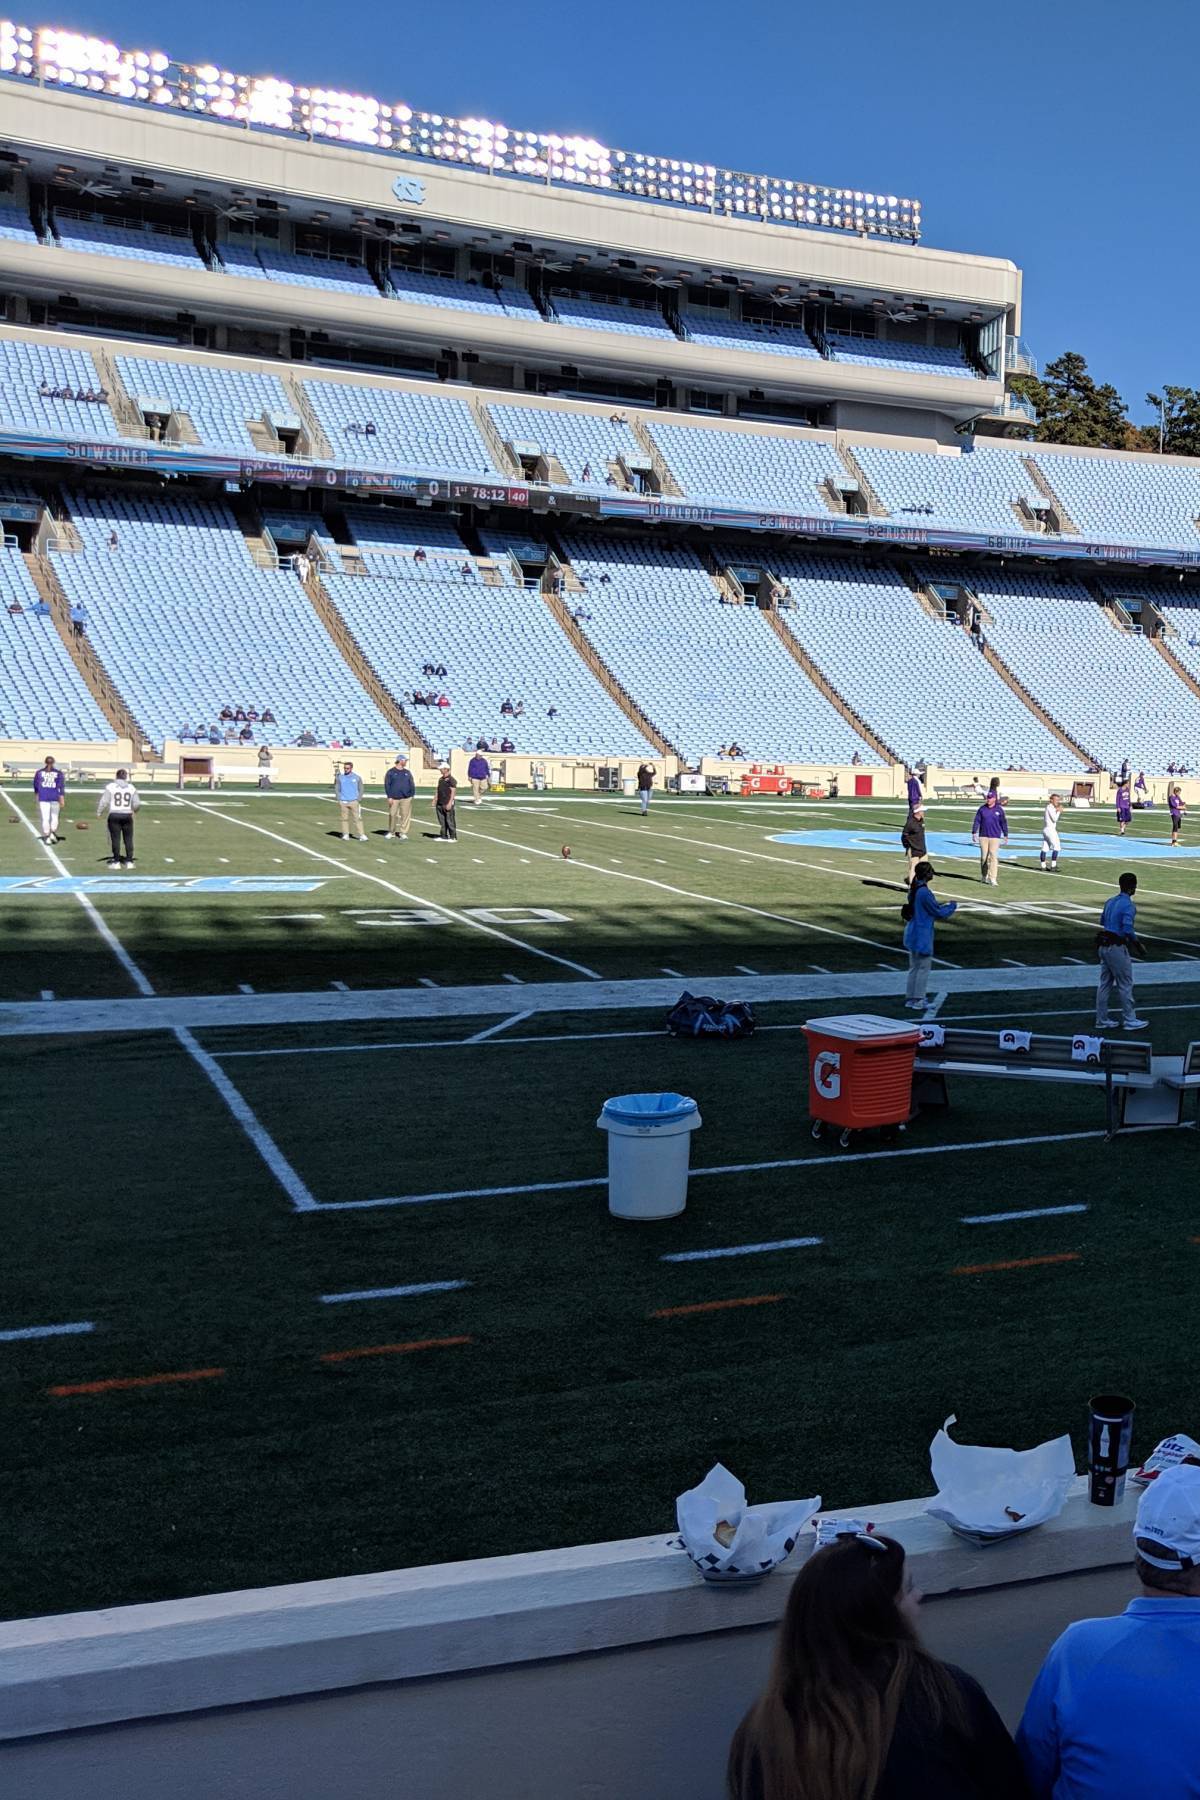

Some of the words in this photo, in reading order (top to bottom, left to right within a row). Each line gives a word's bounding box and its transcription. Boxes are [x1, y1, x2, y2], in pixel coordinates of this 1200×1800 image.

[93, 445, 148, 465] WEINER
[286, 468, 313, 480] WCU
[326, 470, 337, 485] 0
[393, 480, 417, 491] UNC
[428, 481, 440, 496] 0
[471, 487, 505, 500] 78:12
[512, 492, 525, 502] 40
[664, 505, 713, 522] TALBOTT
[759, 515, 776, 528] 23
[867, 524, 884, 538] 62
[113, 792, 132, 807] 89
[813, 1051, 841, 1099] G
